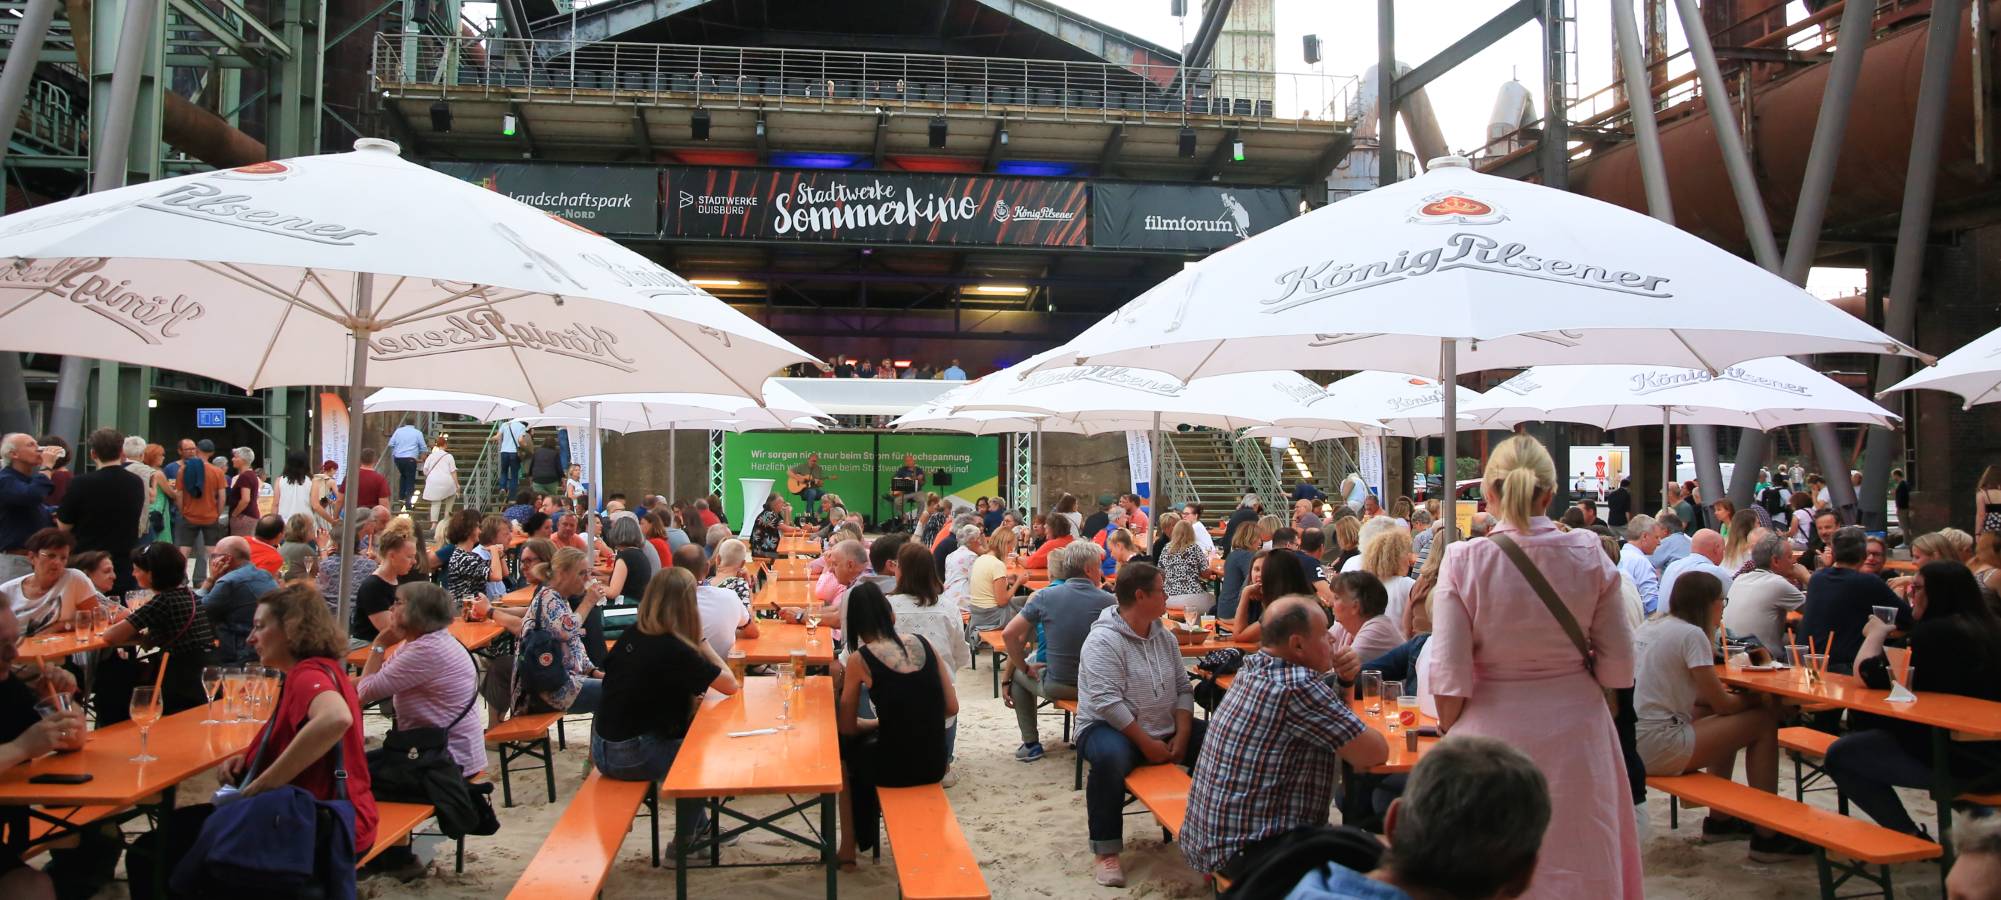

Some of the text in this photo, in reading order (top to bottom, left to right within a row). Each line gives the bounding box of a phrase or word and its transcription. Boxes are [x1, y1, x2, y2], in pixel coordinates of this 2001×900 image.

[797, 179, 896, 205] Stadtwerke
[698, 196, 758, 206] STADTWERKE
[698, 205, 744, 215] DUISBURG
[774, 187, 979, 234] Sommerkino
[1144, 215, 1234, 232] filmforum
[751, 450, 766, 459] Wir
[768, 451, 798, 461] sorgen
[823, 452, 838, 460] nur
[840, 451, 861, 460] beim
[892, 452, 904, 461] für
[751, 462, 785, 471] Herzlich
[840, 462, 861, 472] beim
